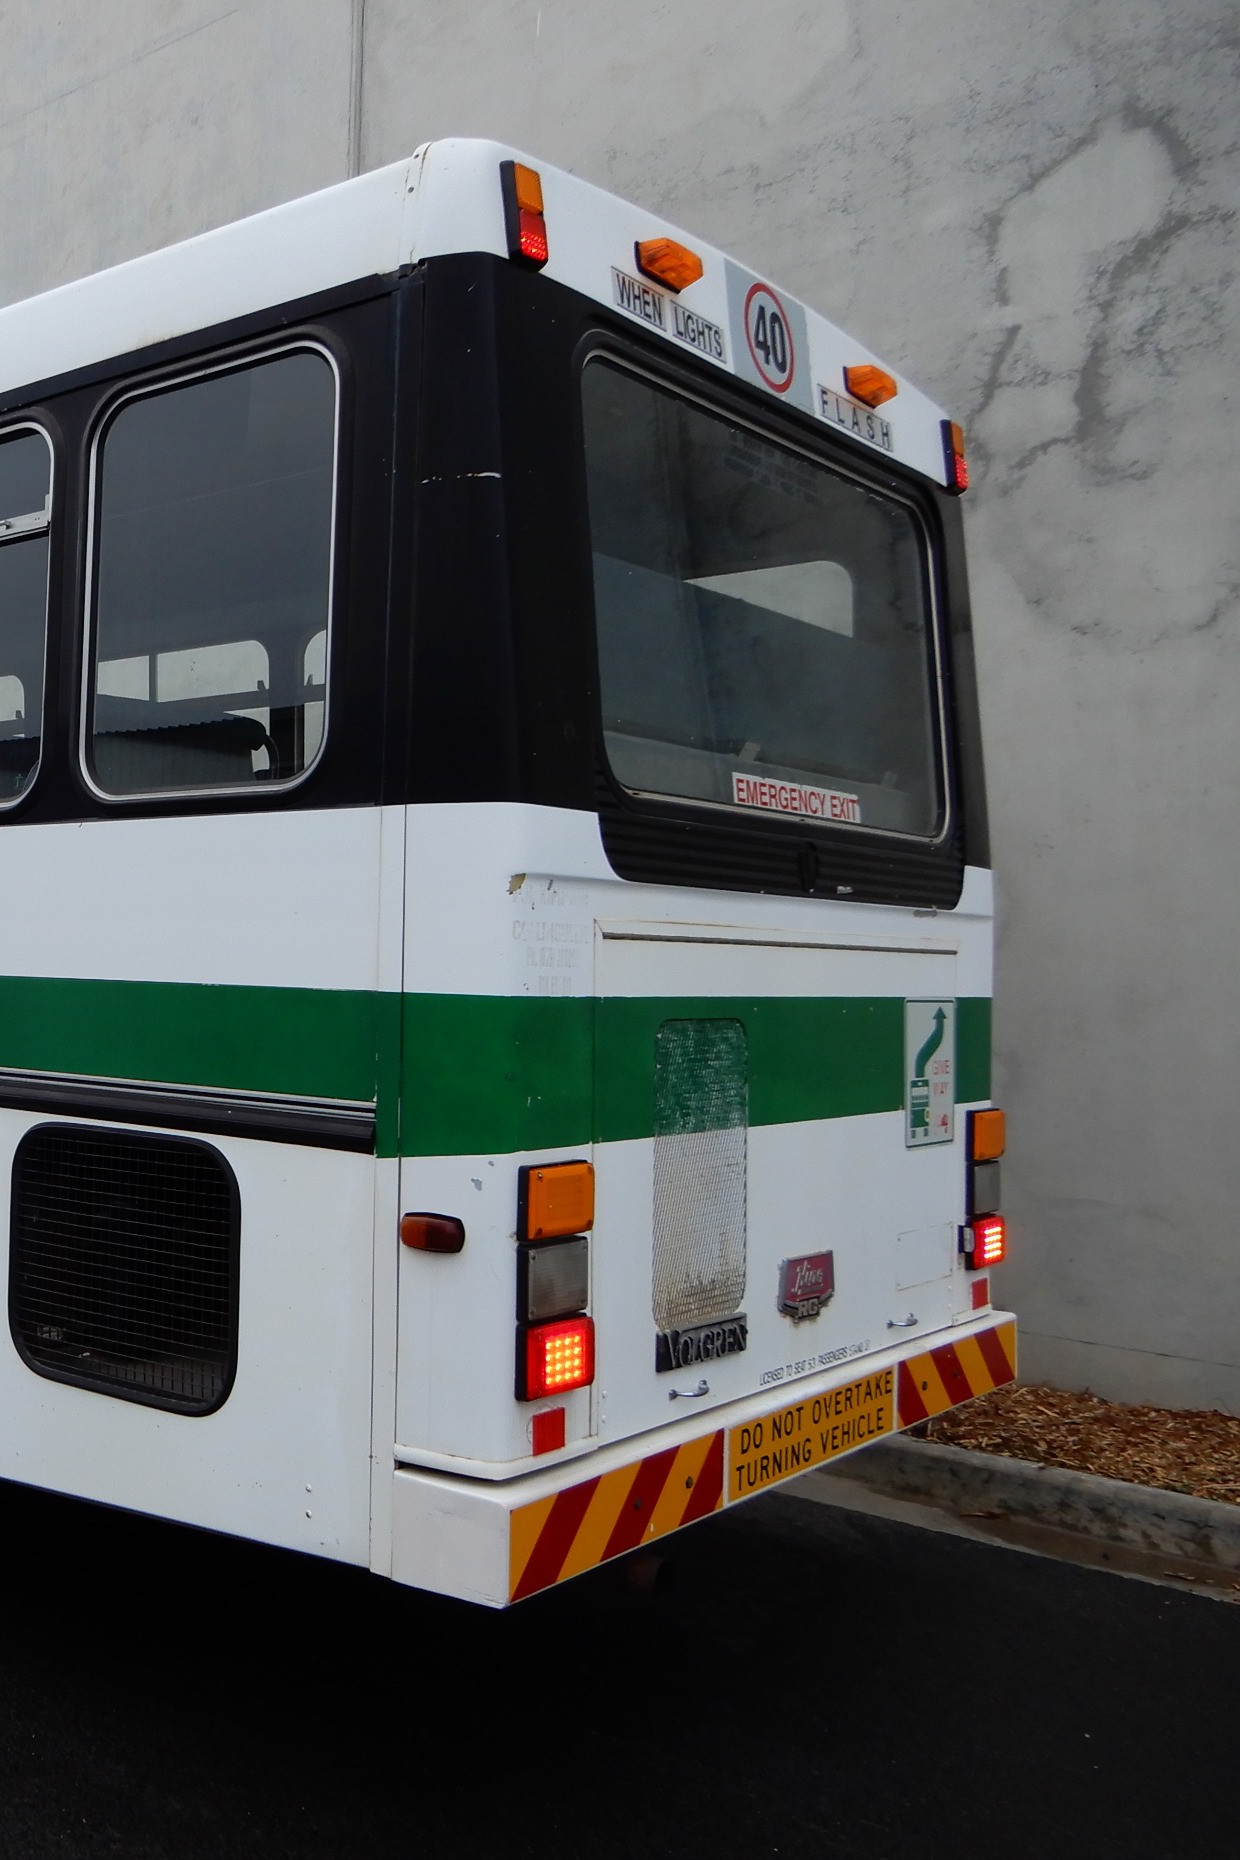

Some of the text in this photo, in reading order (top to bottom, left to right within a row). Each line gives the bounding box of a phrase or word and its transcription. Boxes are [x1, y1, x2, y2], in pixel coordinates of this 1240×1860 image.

[616, 272, 723, 358] WHEN LIGHTS
[754, 304, 787, 375] 40
[820, 389, 892, 449] FLASH
[735, 778, 858, 821] EMERGENCY EXIT
[735, 1407, 885, 1492] TURNING VEHICLE
[740, 1370, 893, 1455] DO NOT OVERTAKE
